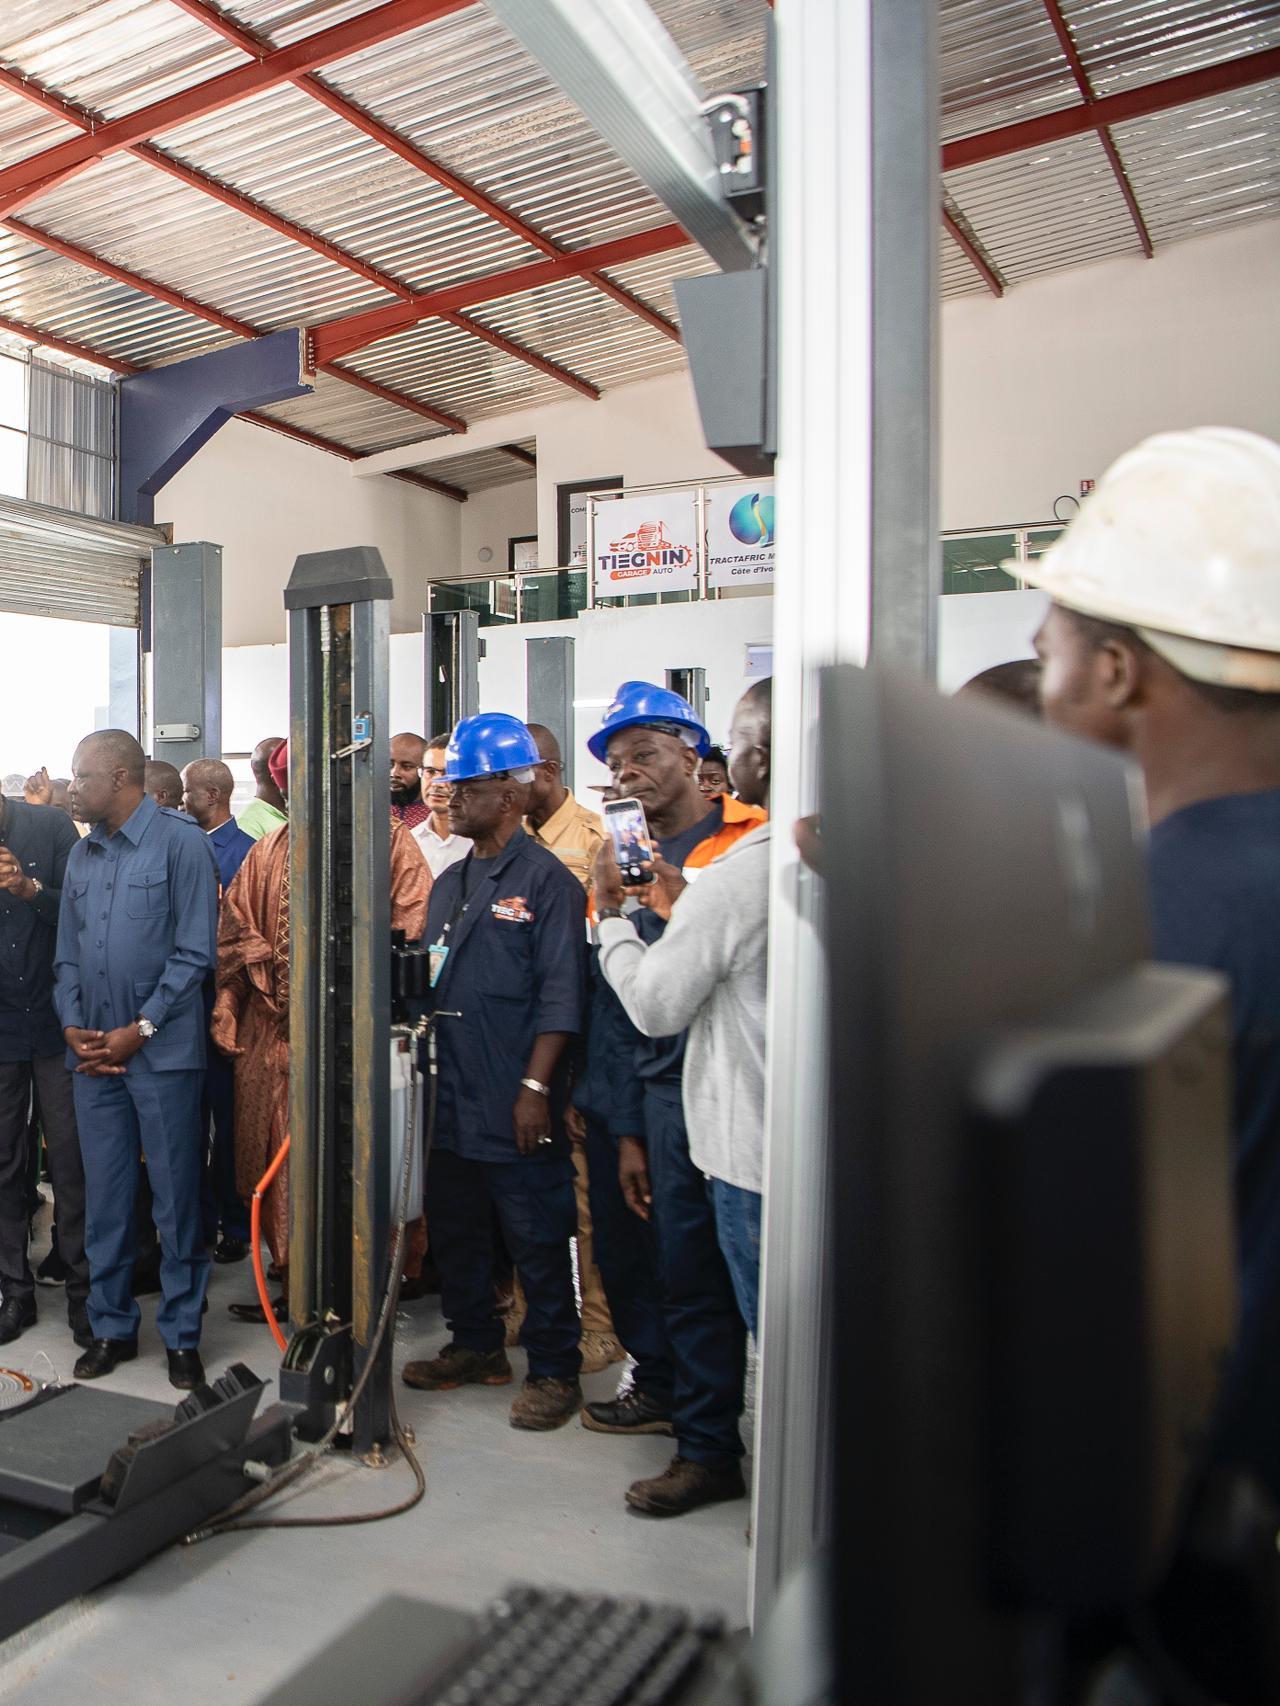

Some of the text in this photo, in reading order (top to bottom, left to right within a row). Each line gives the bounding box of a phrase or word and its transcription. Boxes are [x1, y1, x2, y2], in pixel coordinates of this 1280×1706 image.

[598, 549, 684, 570] TIEGNIN
[709, 553, 766, 565] TRACTAFRIC
[617, 567, 673, 578] GARAGE AUTO
[731, 566, 776, 576] Côte d'Ivo
